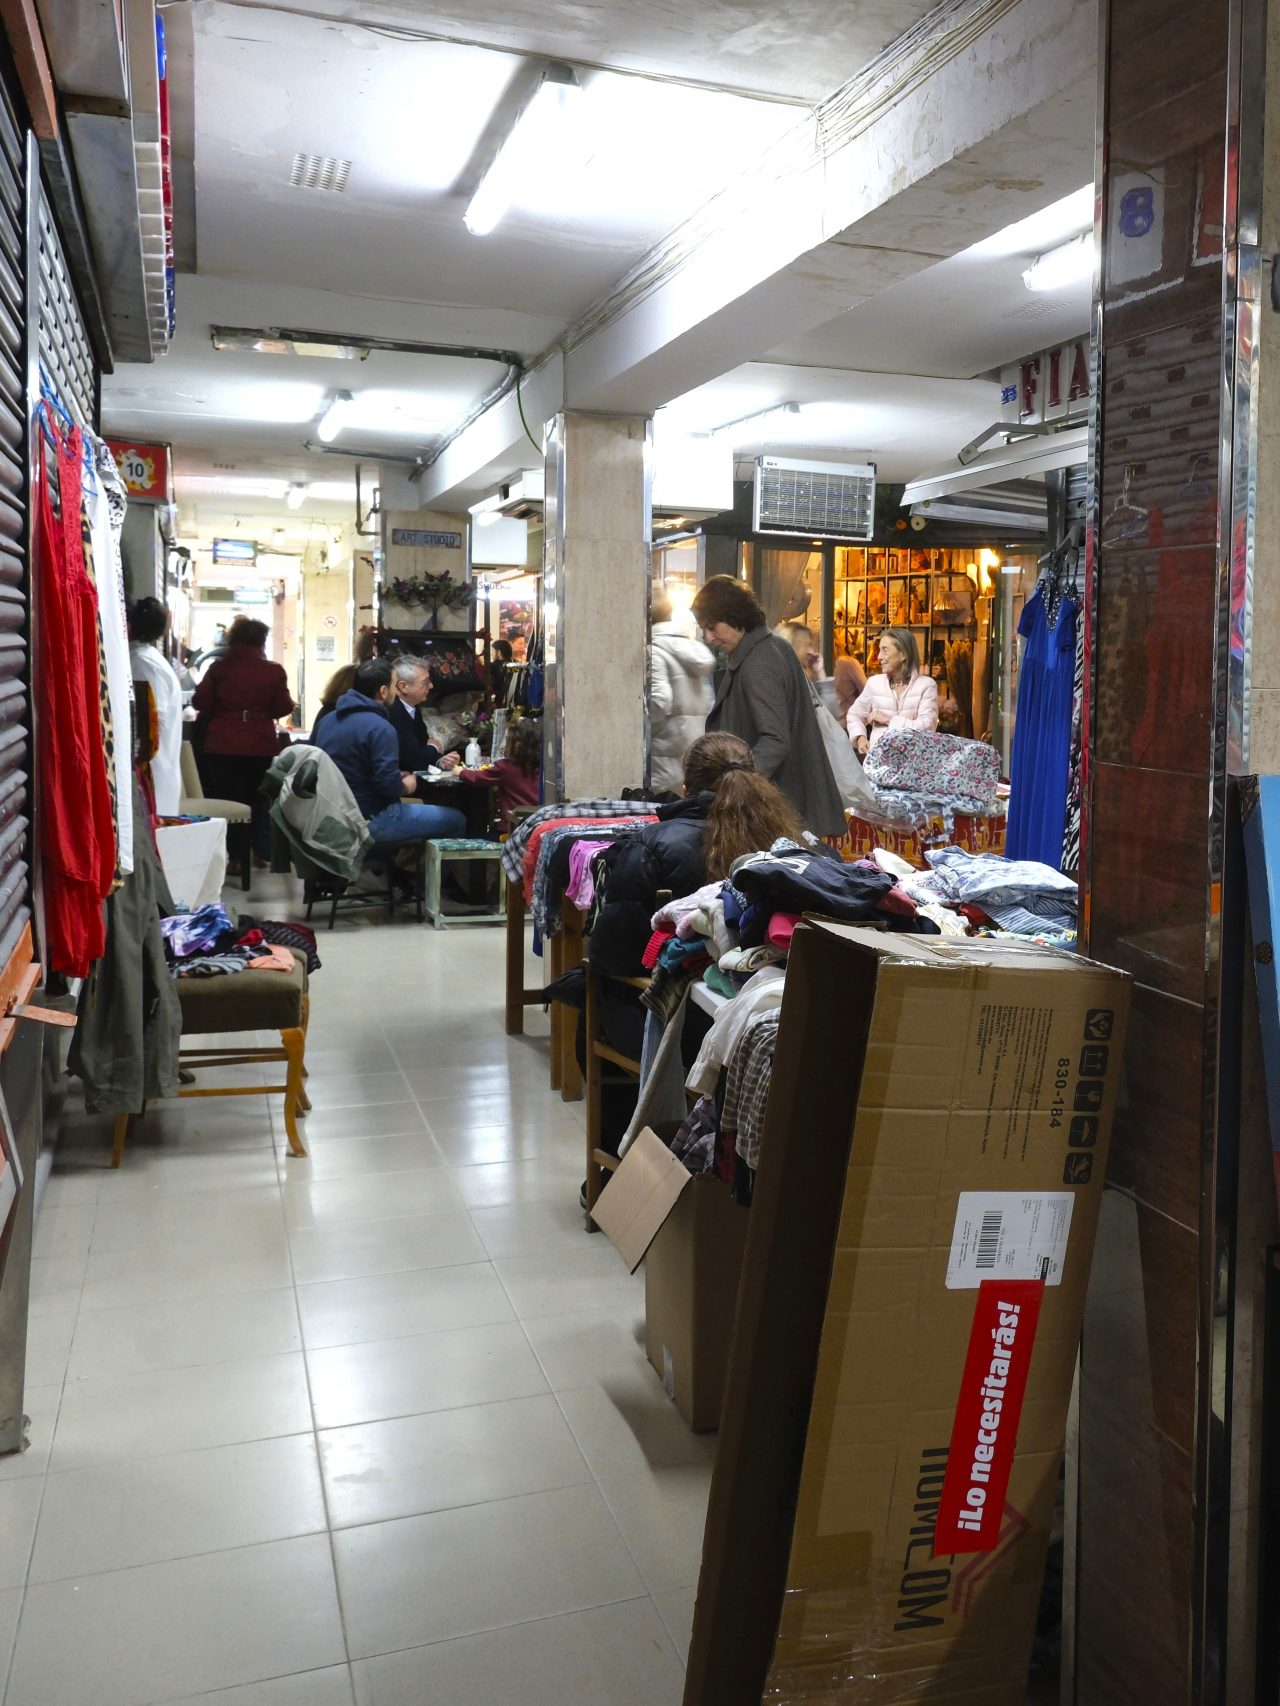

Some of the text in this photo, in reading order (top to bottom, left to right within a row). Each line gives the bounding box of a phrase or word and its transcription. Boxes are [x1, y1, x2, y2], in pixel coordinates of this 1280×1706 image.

[127, 463, 144, 478] 10
[401, 533, 455, 546] ART STUDIO
[1049, 1058, 1070, 1129] 830-184
[957, 1300, 1021, 1532] ¡Lo necesitarás!
